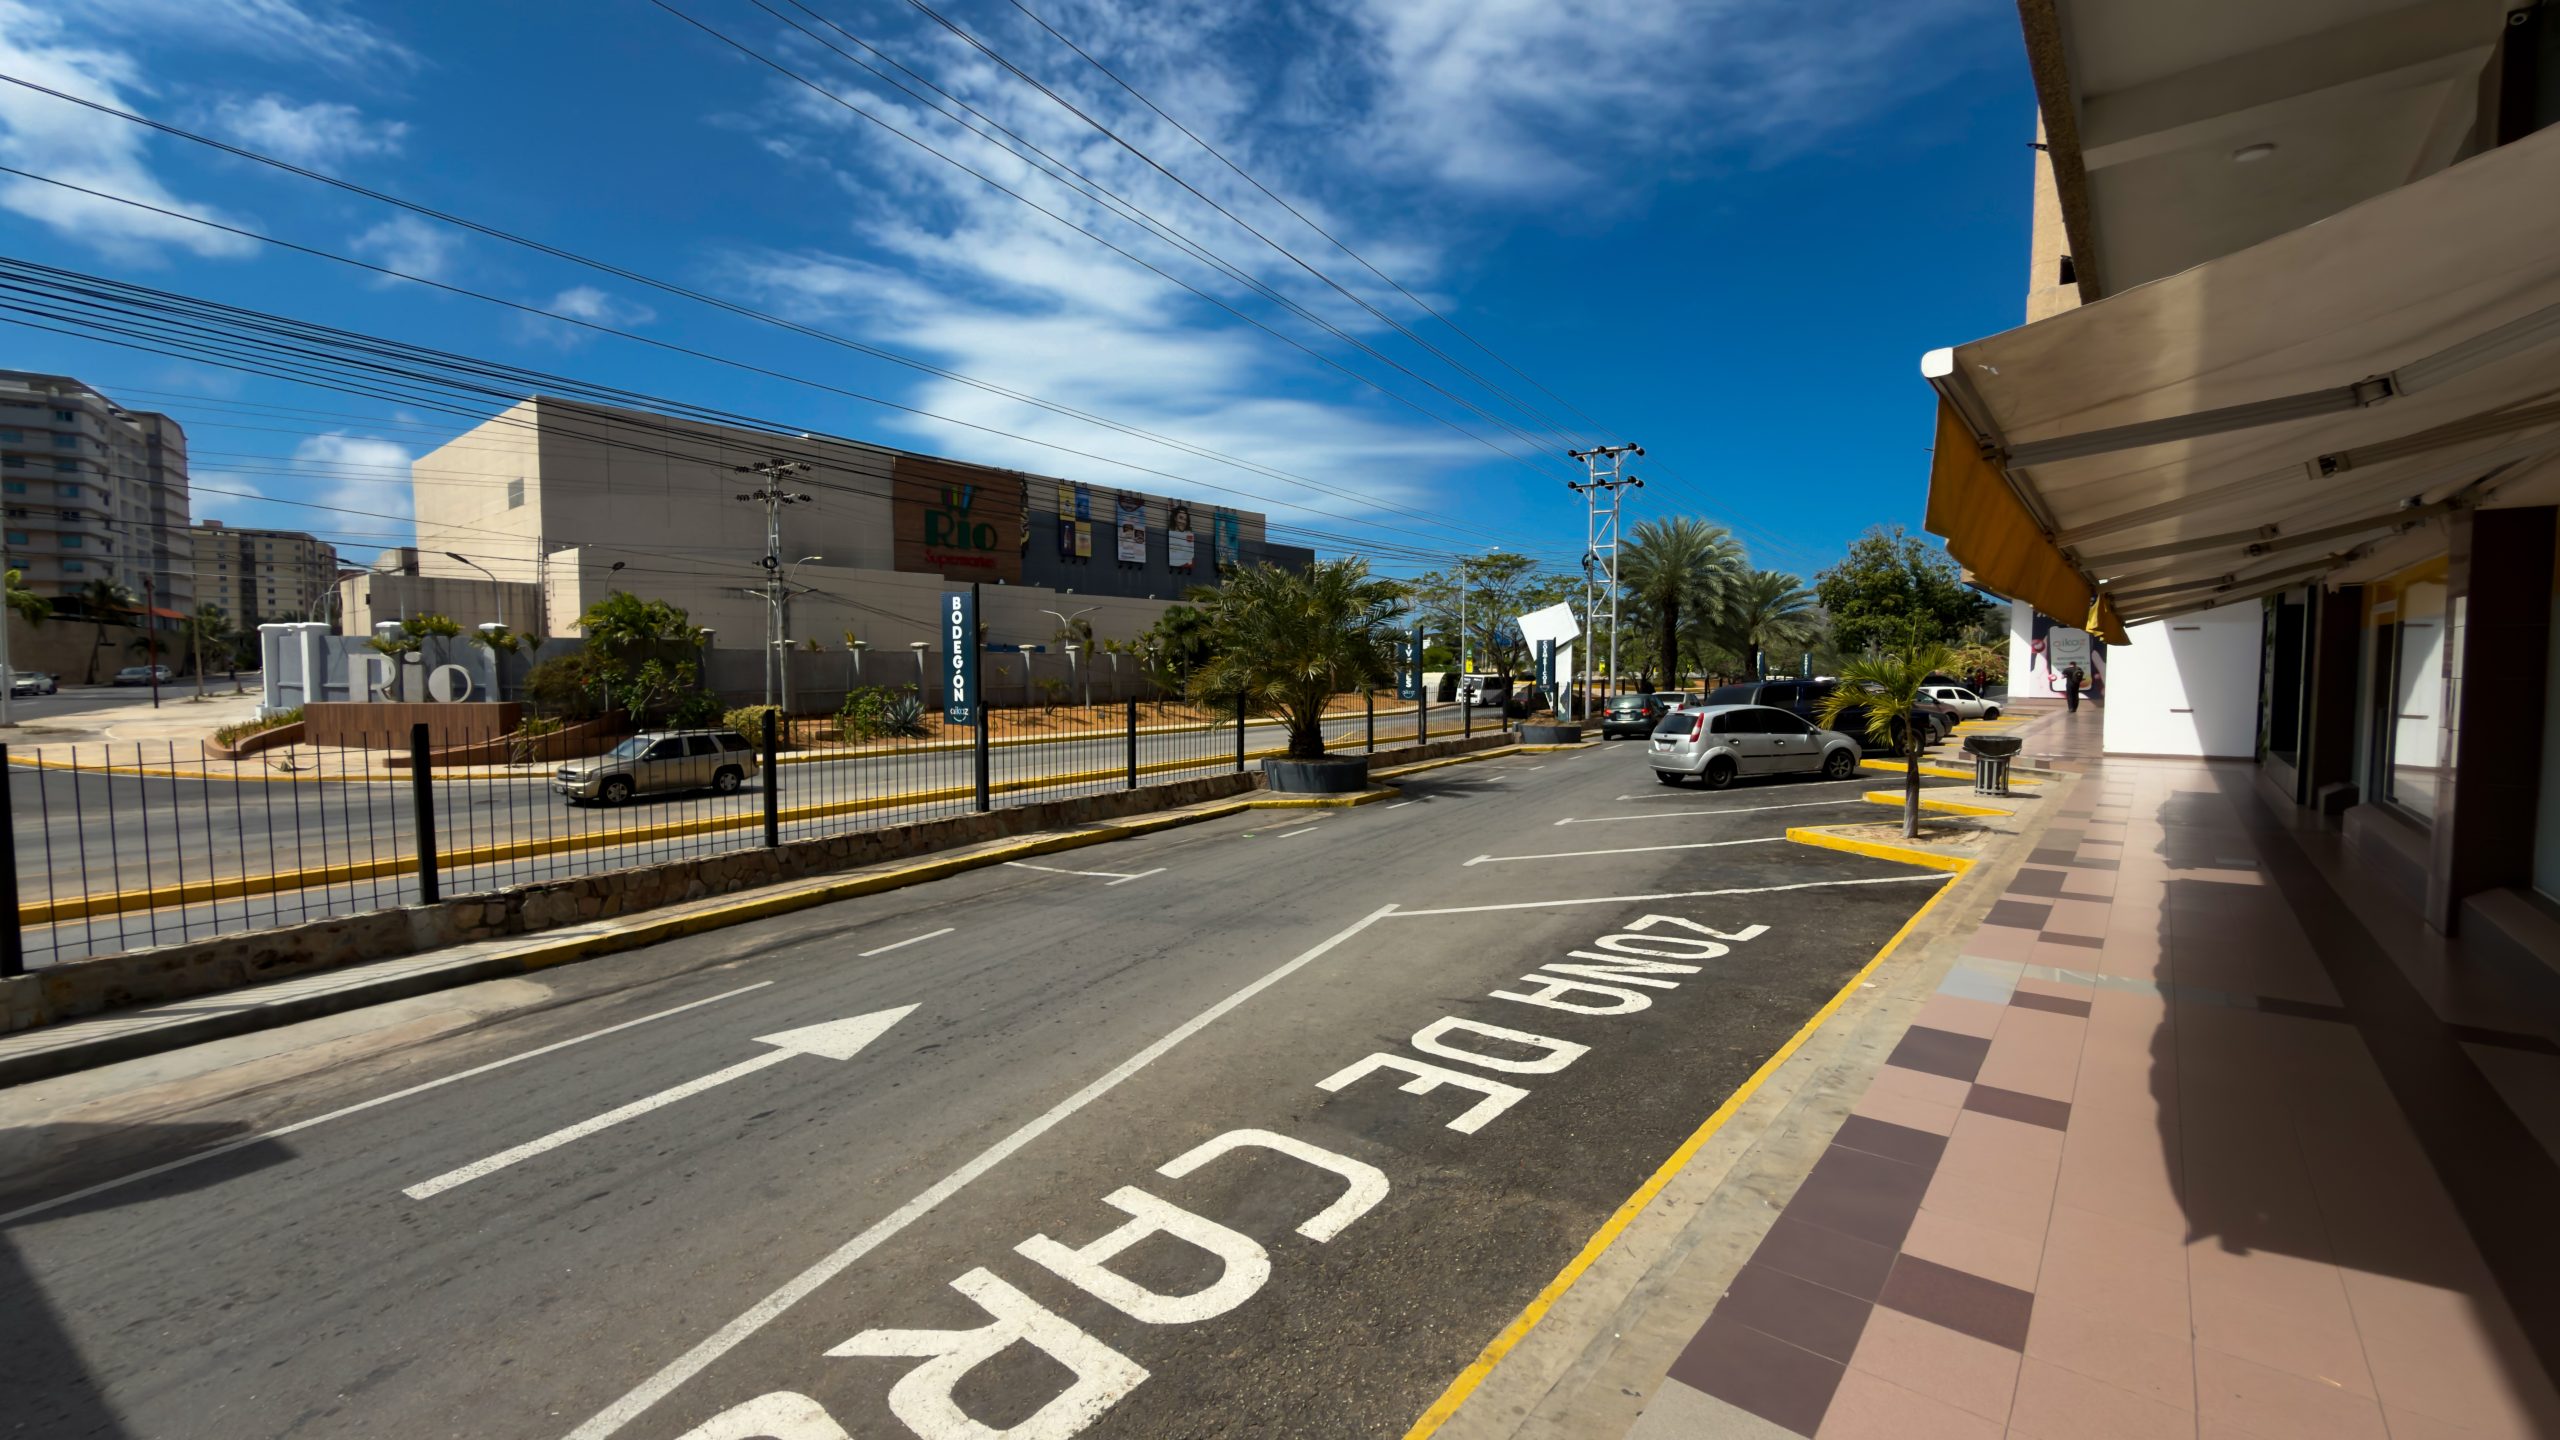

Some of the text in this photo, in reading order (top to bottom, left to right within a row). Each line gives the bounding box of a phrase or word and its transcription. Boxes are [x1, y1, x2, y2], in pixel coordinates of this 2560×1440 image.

[348, 651, 473, 703] Rio
[1488, 914, 1771, 1016] ZONA
[1315, 1015, 1592, 1135] DE
